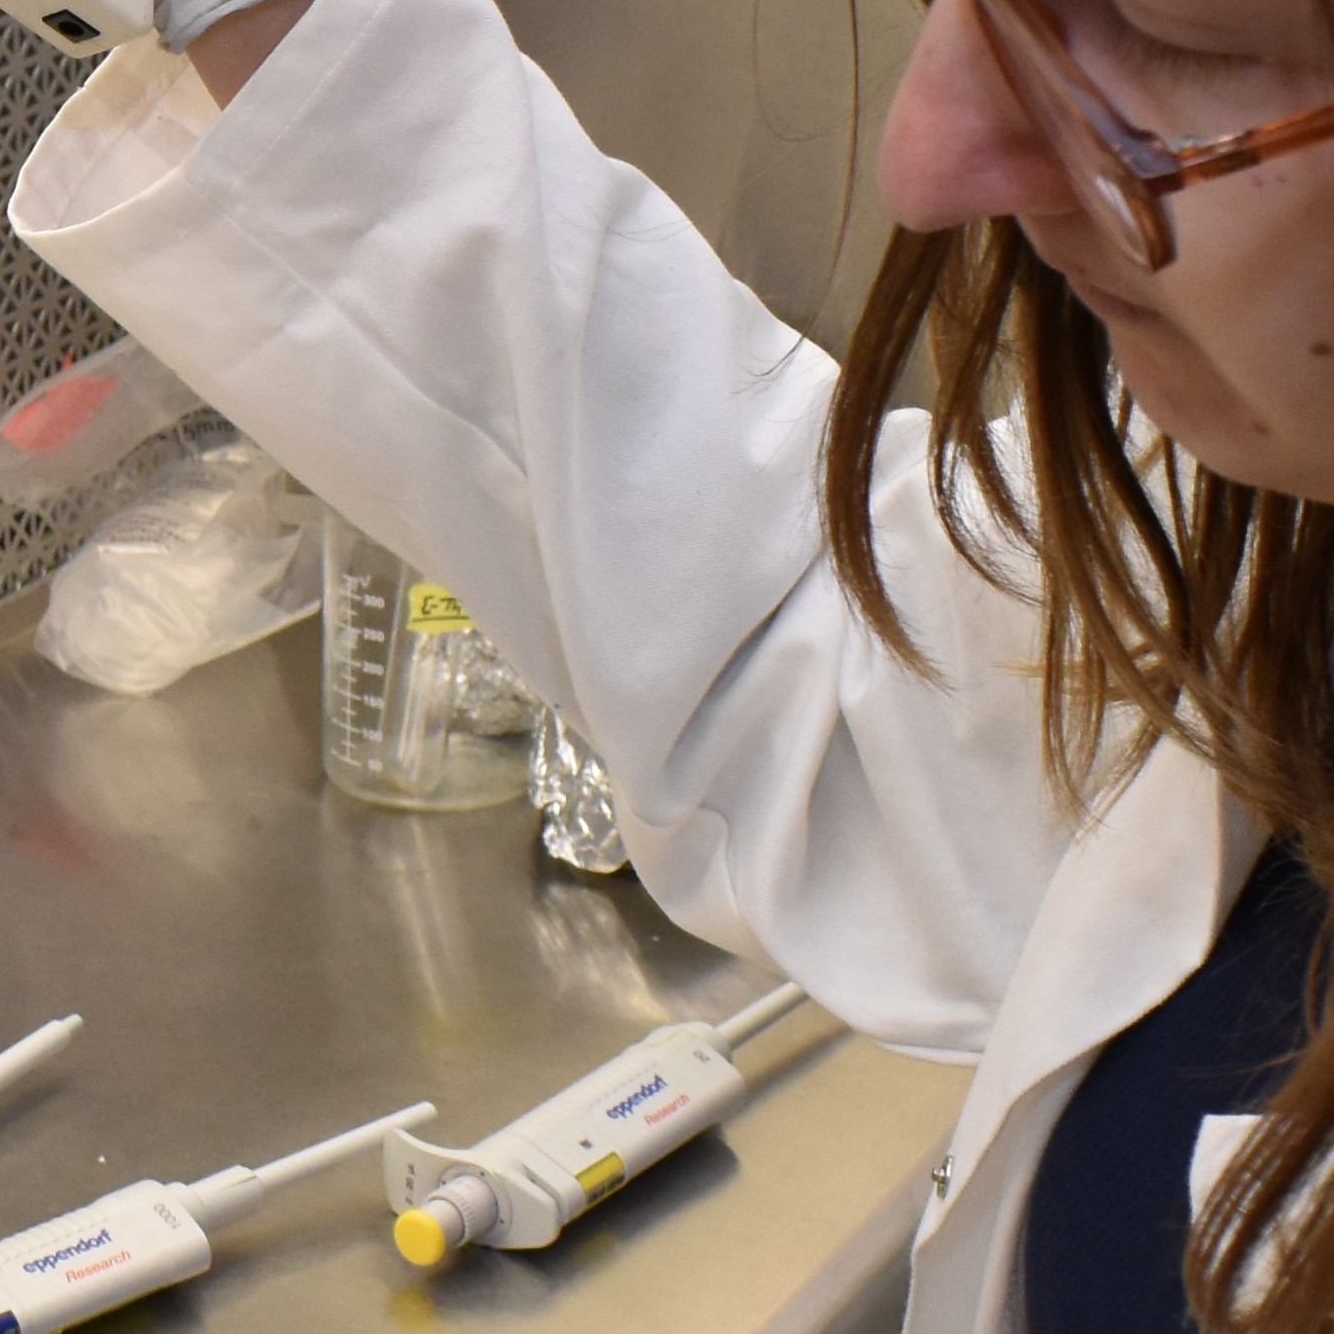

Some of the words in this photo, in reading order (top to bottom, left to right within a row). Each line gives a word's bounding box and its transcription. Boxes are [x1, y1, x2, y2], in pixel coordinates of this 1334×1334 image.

[606, 1073, 669, 1119] eppendorf
[644, 1093, 690, 1126] Research
[23, 1227, 113, 1273] eppendorf
[65, 1249, 132, 1283] Research
